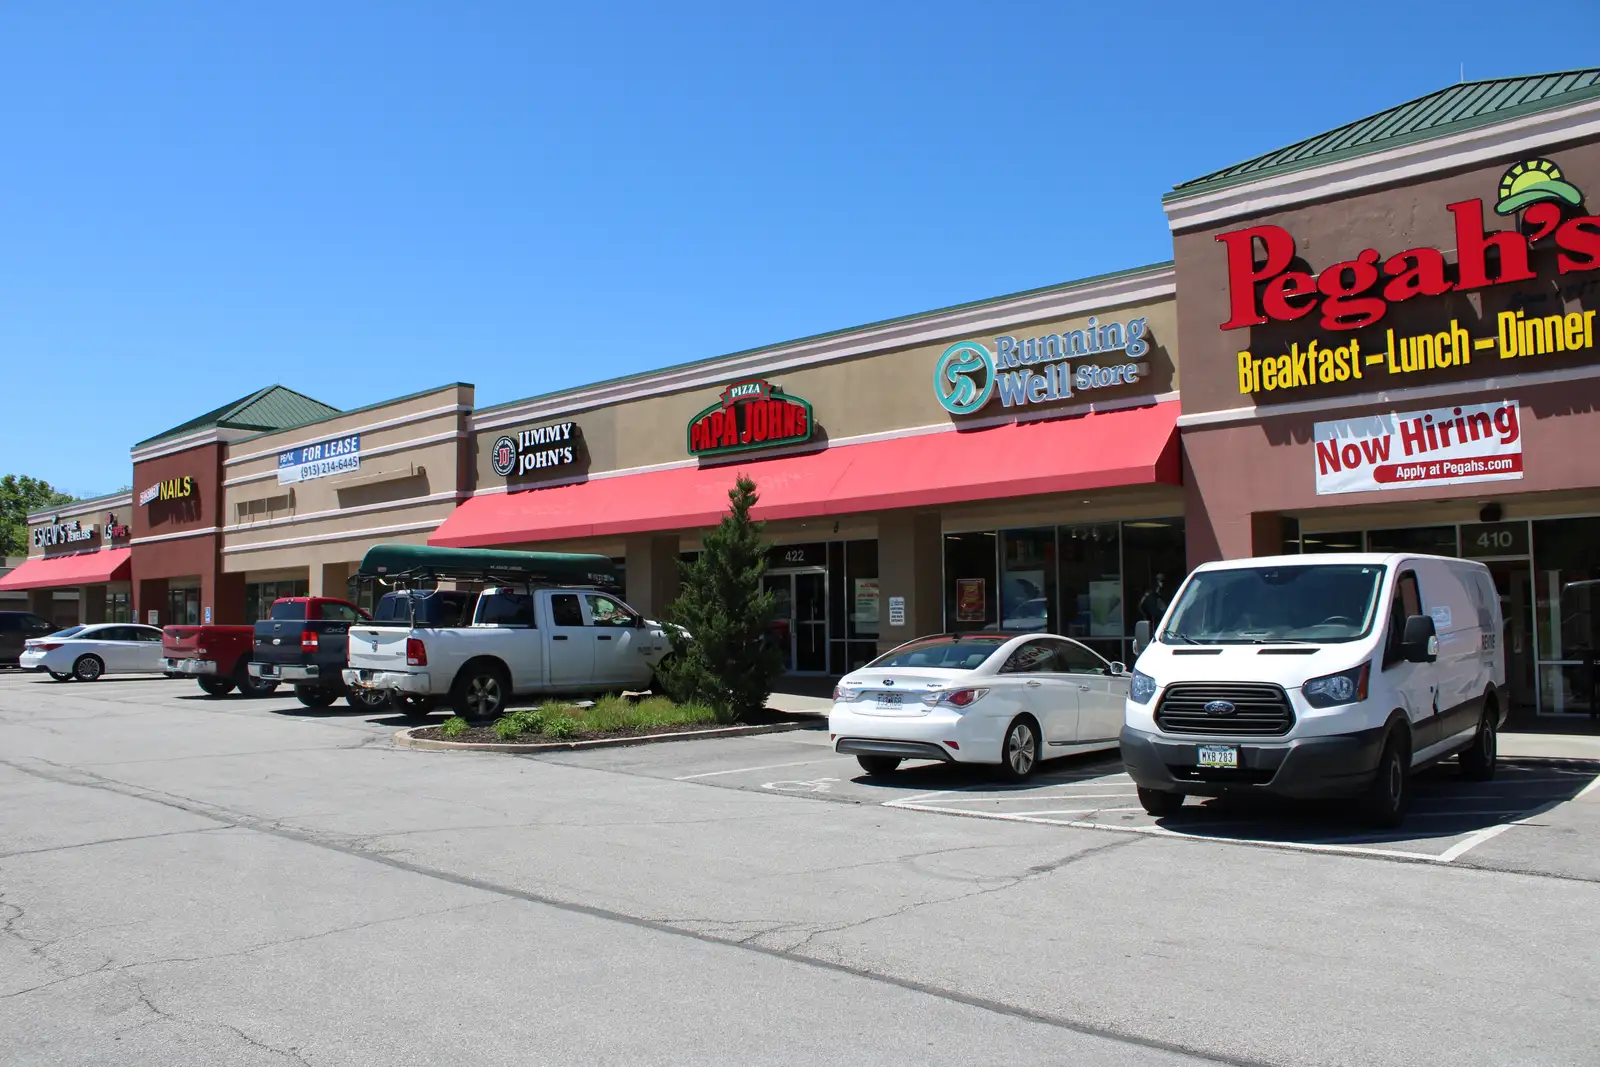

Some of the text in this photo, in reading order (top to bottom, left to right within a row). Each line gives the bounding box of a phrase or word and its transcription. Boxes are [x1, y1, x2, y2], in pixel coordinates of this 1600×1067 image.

[1215, 198, 1600, 331] Pegah's
[995, 316, 1150, 370] Running
[731, 383, 760, 398] PIZZA
[995, 361, 1139, 408] Well Store
[518, 422, 572, 452] JIMMY
[691, 404, 738, 451] PAPA
[1316, 404, 1520, 476] Now Hiring
[302, 436, 358, 462] FOR LEASE
[518, 446, 573, 476] JOHN'S
[301, 456, 358, 478] (913) 214-6445
[1395, 457, 1513, 480] Apply at Pegahs.com
[160, 475, 191, 501] NAILS
[33, 524, 66, 547] ESKEW'S
[1476, 530, 1513, 548] 410
[785, 549, 805, 562] 422
[1218, 752, 1233, 763] 283
